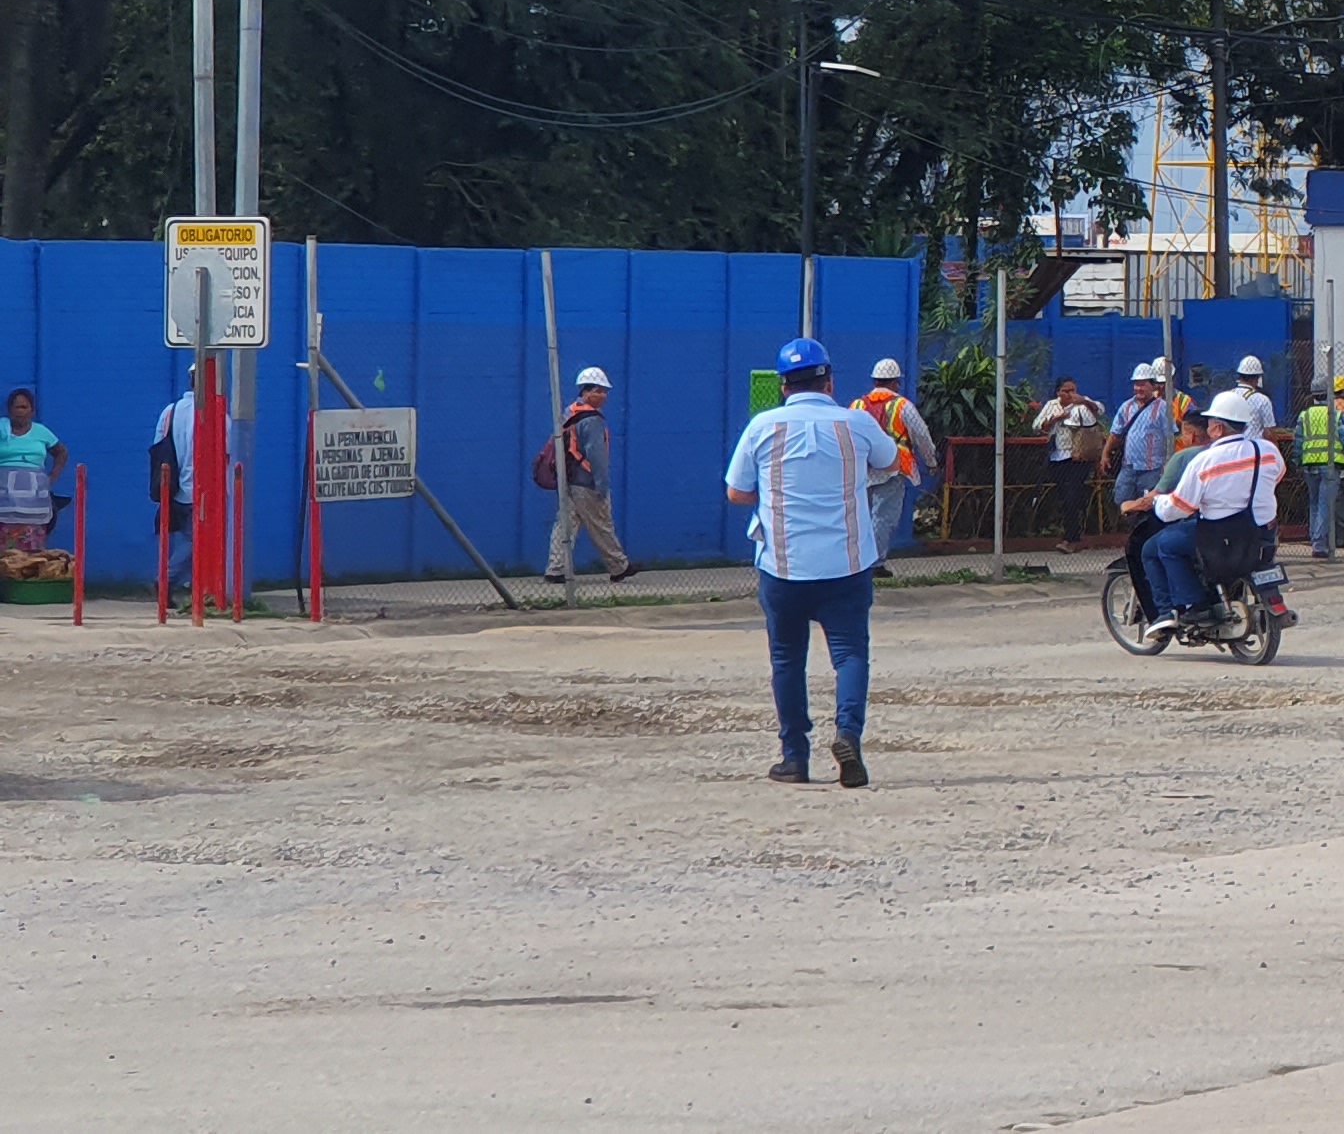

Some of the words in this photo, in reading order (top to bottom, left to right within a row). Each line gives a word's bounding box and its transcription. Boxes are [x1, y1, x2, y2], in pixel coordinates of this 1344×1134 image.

[180, 229, 253, 242] OBLIGATORIO
[254, 286, 261, 299] Y
[324, 433, 335, 447] LA
[338, 430, 398, 446] PERMANENCIA
[322, 448, 363, 464] PERSONAS
[370, 447, 405, 462] AJENAS
